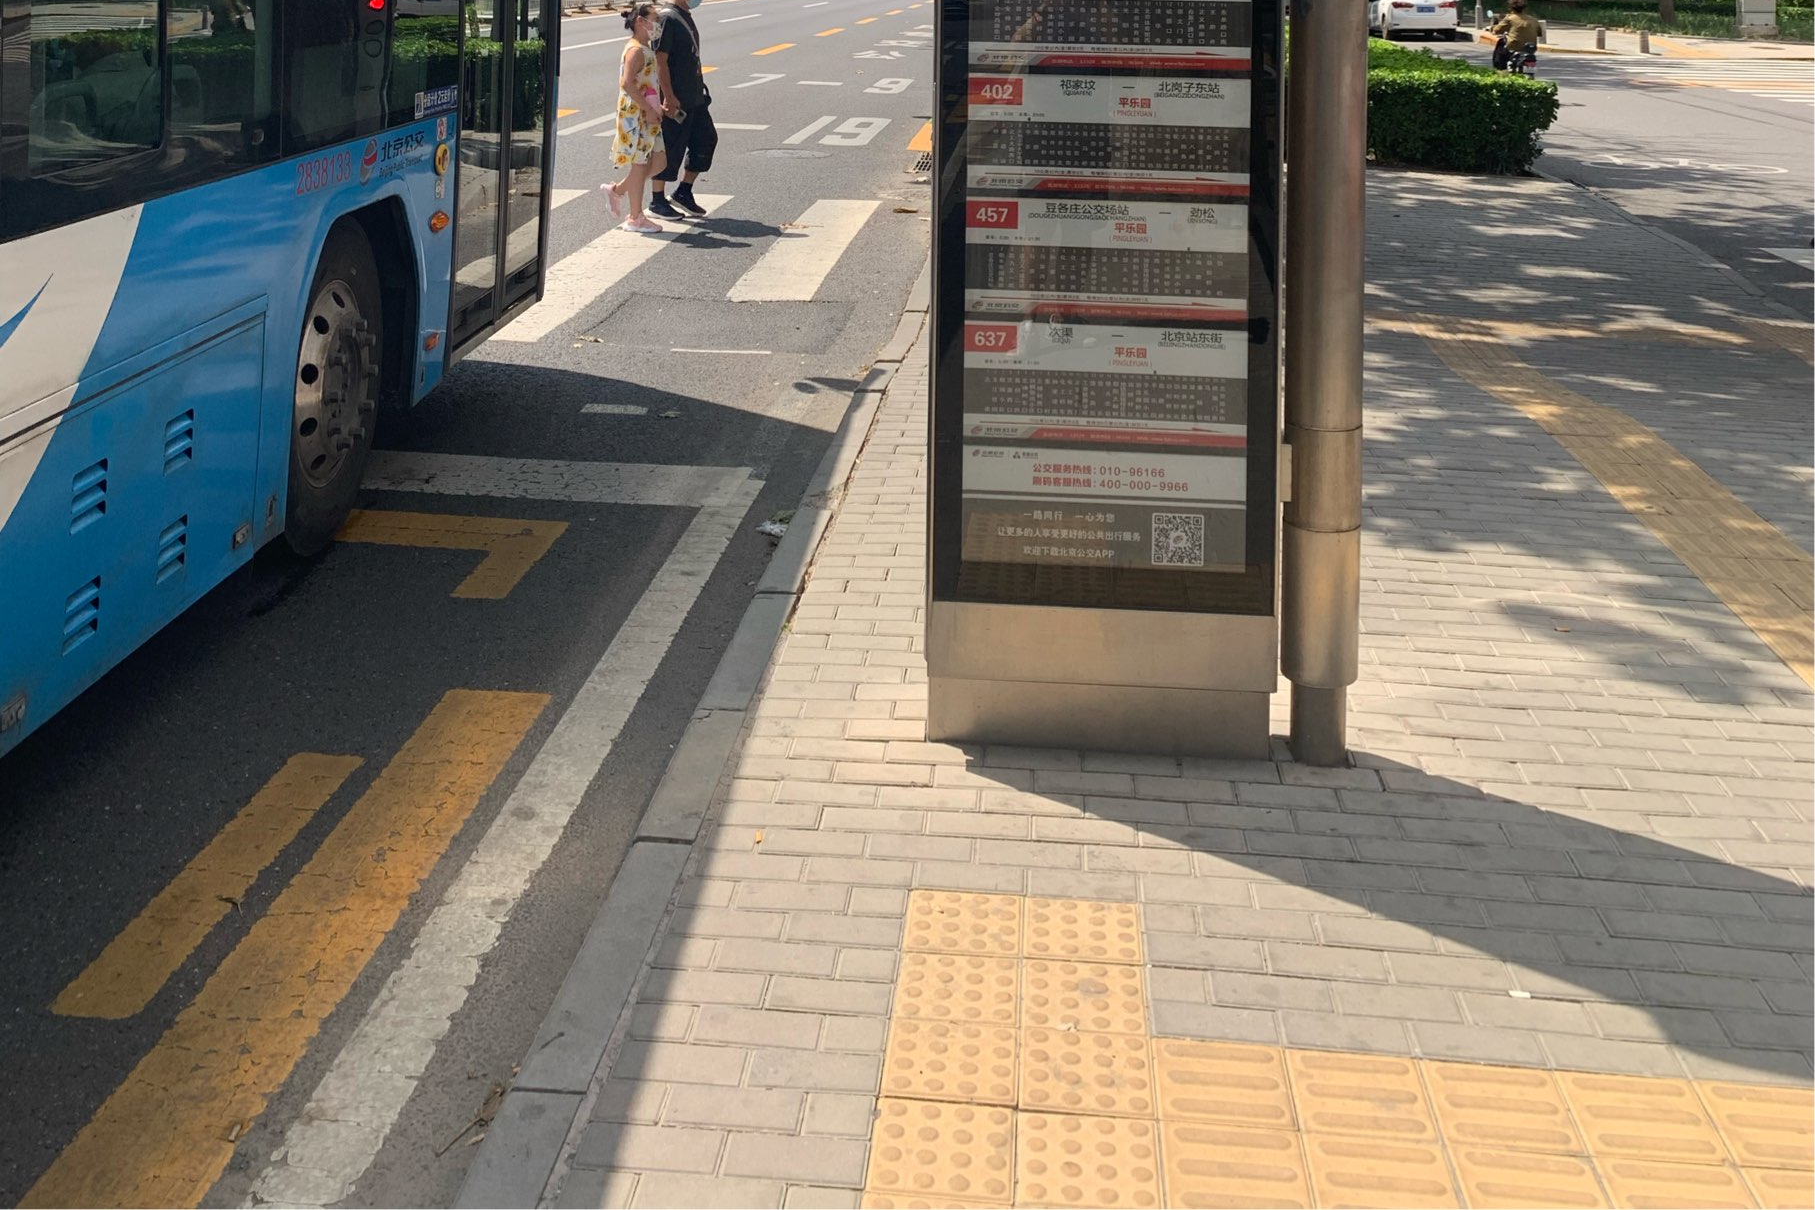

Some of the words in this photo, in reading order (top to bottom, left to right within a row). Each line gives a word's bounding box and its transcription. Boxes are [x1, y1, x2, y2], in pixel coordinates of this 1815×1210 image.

[981, 85, 1013, 100] 402
[1060, 79, 1096, 91] 祁家坟
[1158, 81, 1220, 93] 北岗子东站
[1118, 97, 1151, 109] 平乐园
[380, 131, 424, 162] 北京公交
[296, 151, 351, 194] 2838133
[977, 208, 1009, 222] 457
[1046, 202, 1129, 215] 豆各庄公交场站
[1190, 208, 1215, 219] 劲松
[1114, 223, 1147, 234] 平乐园
[974, 332, 1007, 346] 637
[1049, 327, 1073, 338] 次渠
[1161, 331, 1222, 343] 北京站东街
[1114, 347, 1147, 359] 平乐园
